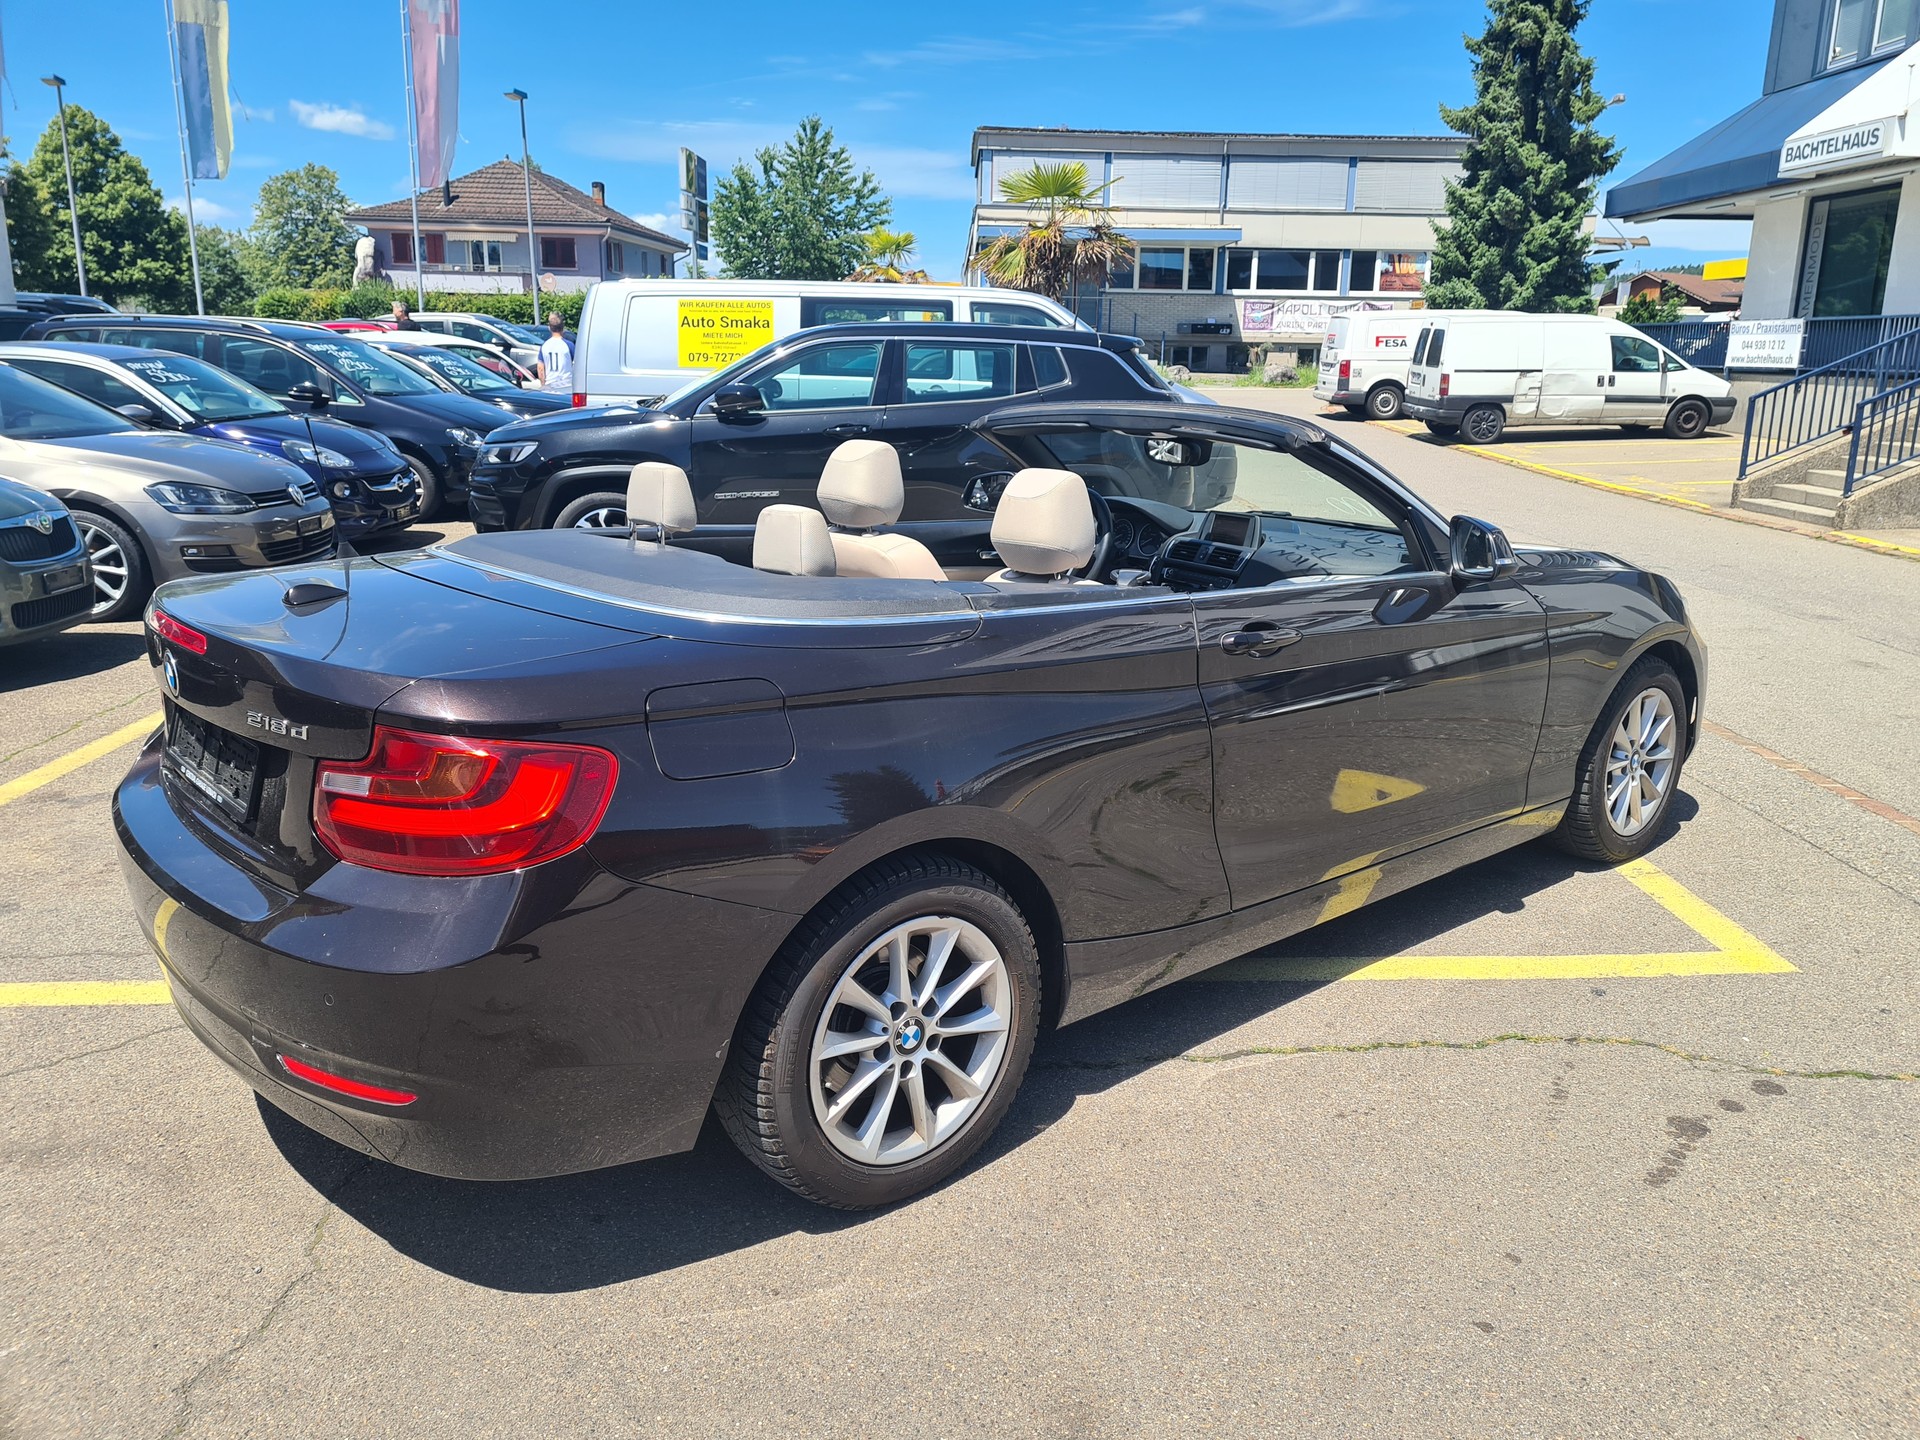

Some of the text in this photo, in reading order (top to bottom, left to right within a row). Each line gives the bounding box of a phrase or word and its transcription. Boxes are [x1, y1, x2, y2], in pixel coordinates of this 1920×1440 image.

[1784, 127, 1881, 163] BACHTELHAUS
[680, 316, 770, 329] Auto Smaka
[1731, 323, 1750, 335] Büros
[1756, 322, 1802, 334] Praxisräume
[1375, 336, 1408, 348] FESA
[1741, 340, 1786, 350] 044 938 12 12
[548, 352, 559, 371] 11
[688, 352, 744, 363] 079-727
[1730, 354, 1794, 364] www.bachtelhaus.ch
